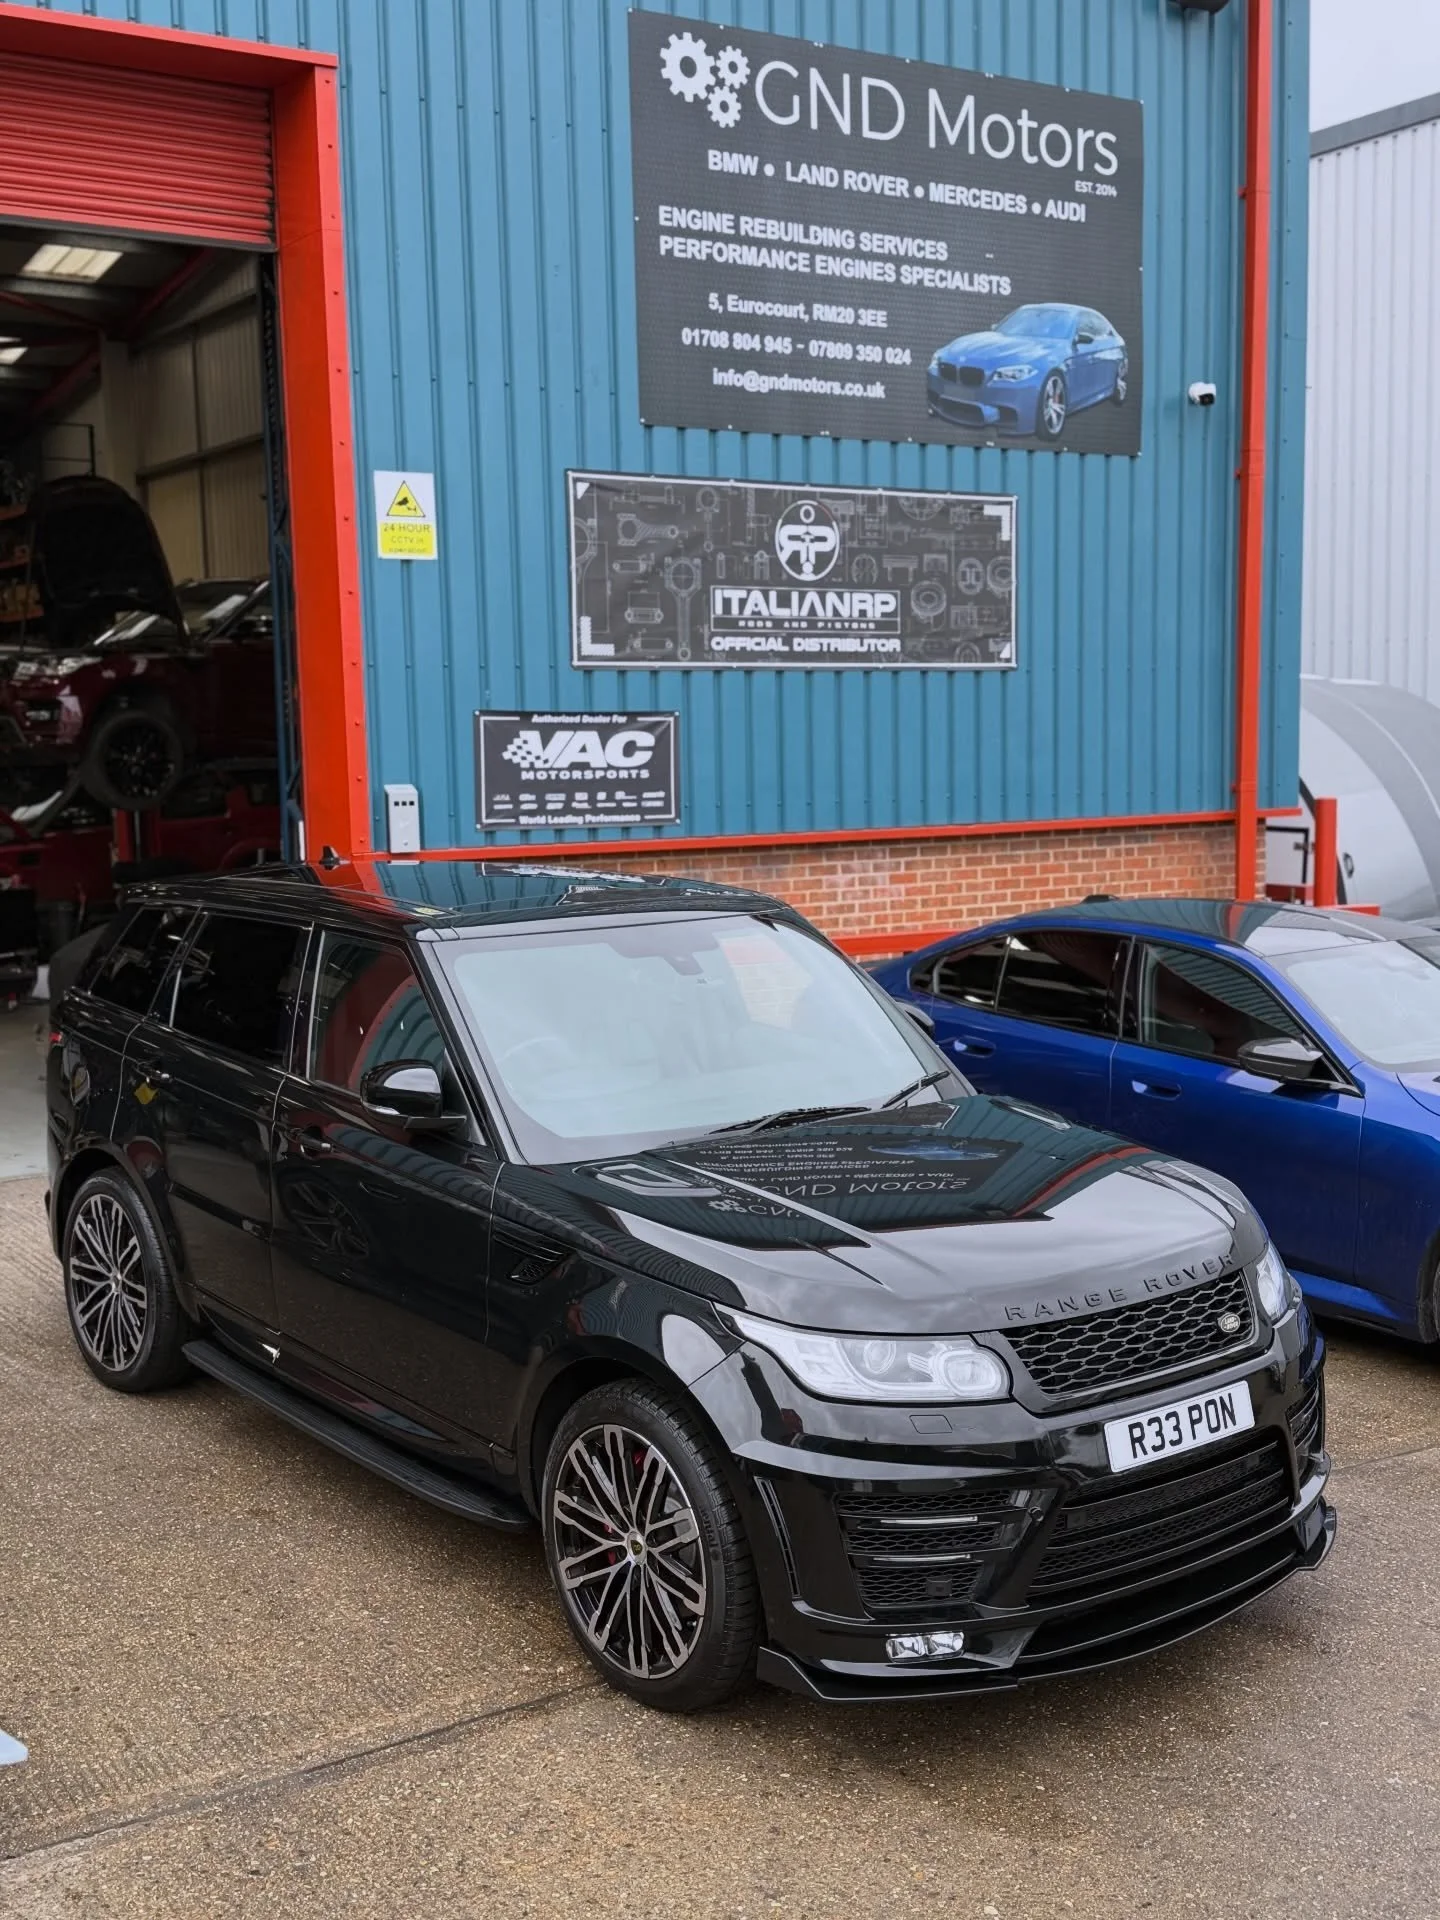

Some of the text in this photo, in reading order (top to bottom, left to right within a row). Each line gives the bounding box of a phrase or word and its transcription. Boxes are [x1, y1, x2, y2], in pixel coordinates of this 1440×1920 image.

[755, 61, 1118, 176] GND Motors
[708, 149, 1086, 222] BMW LAND ROVER MERCEDES AUDI
[658, 205, 948, 261] ENGINE REBUILDING SERVICES
[659, 235, 1012, 296] PERFORMANCE ENGINES SPECIALISTS
[708, 292, 888, 328] 5, Eurocourt, RM20 3EE
[681, 327, 730, 349] 01708
[732, 332, 761, 352] 804
[764, 336, 793, 355] 945
[855, 344, 882, 362] 350
[885, 348, 912, 366] 024
[712, 368, 886, 398] info@gndmotors.co.uk
[399, 523, 430, 533] HOUR
[710, 636, 901, 652] OFFICIAL DISTRIBUTOR
[503, 730, 656, 769] VAC
[521, 769, 650, 781] MOTORSPORTS
[1004, 1255, 1234, 1321] RANGE ROVER
[1127, 1393, 1237, 1459] R33 PON
